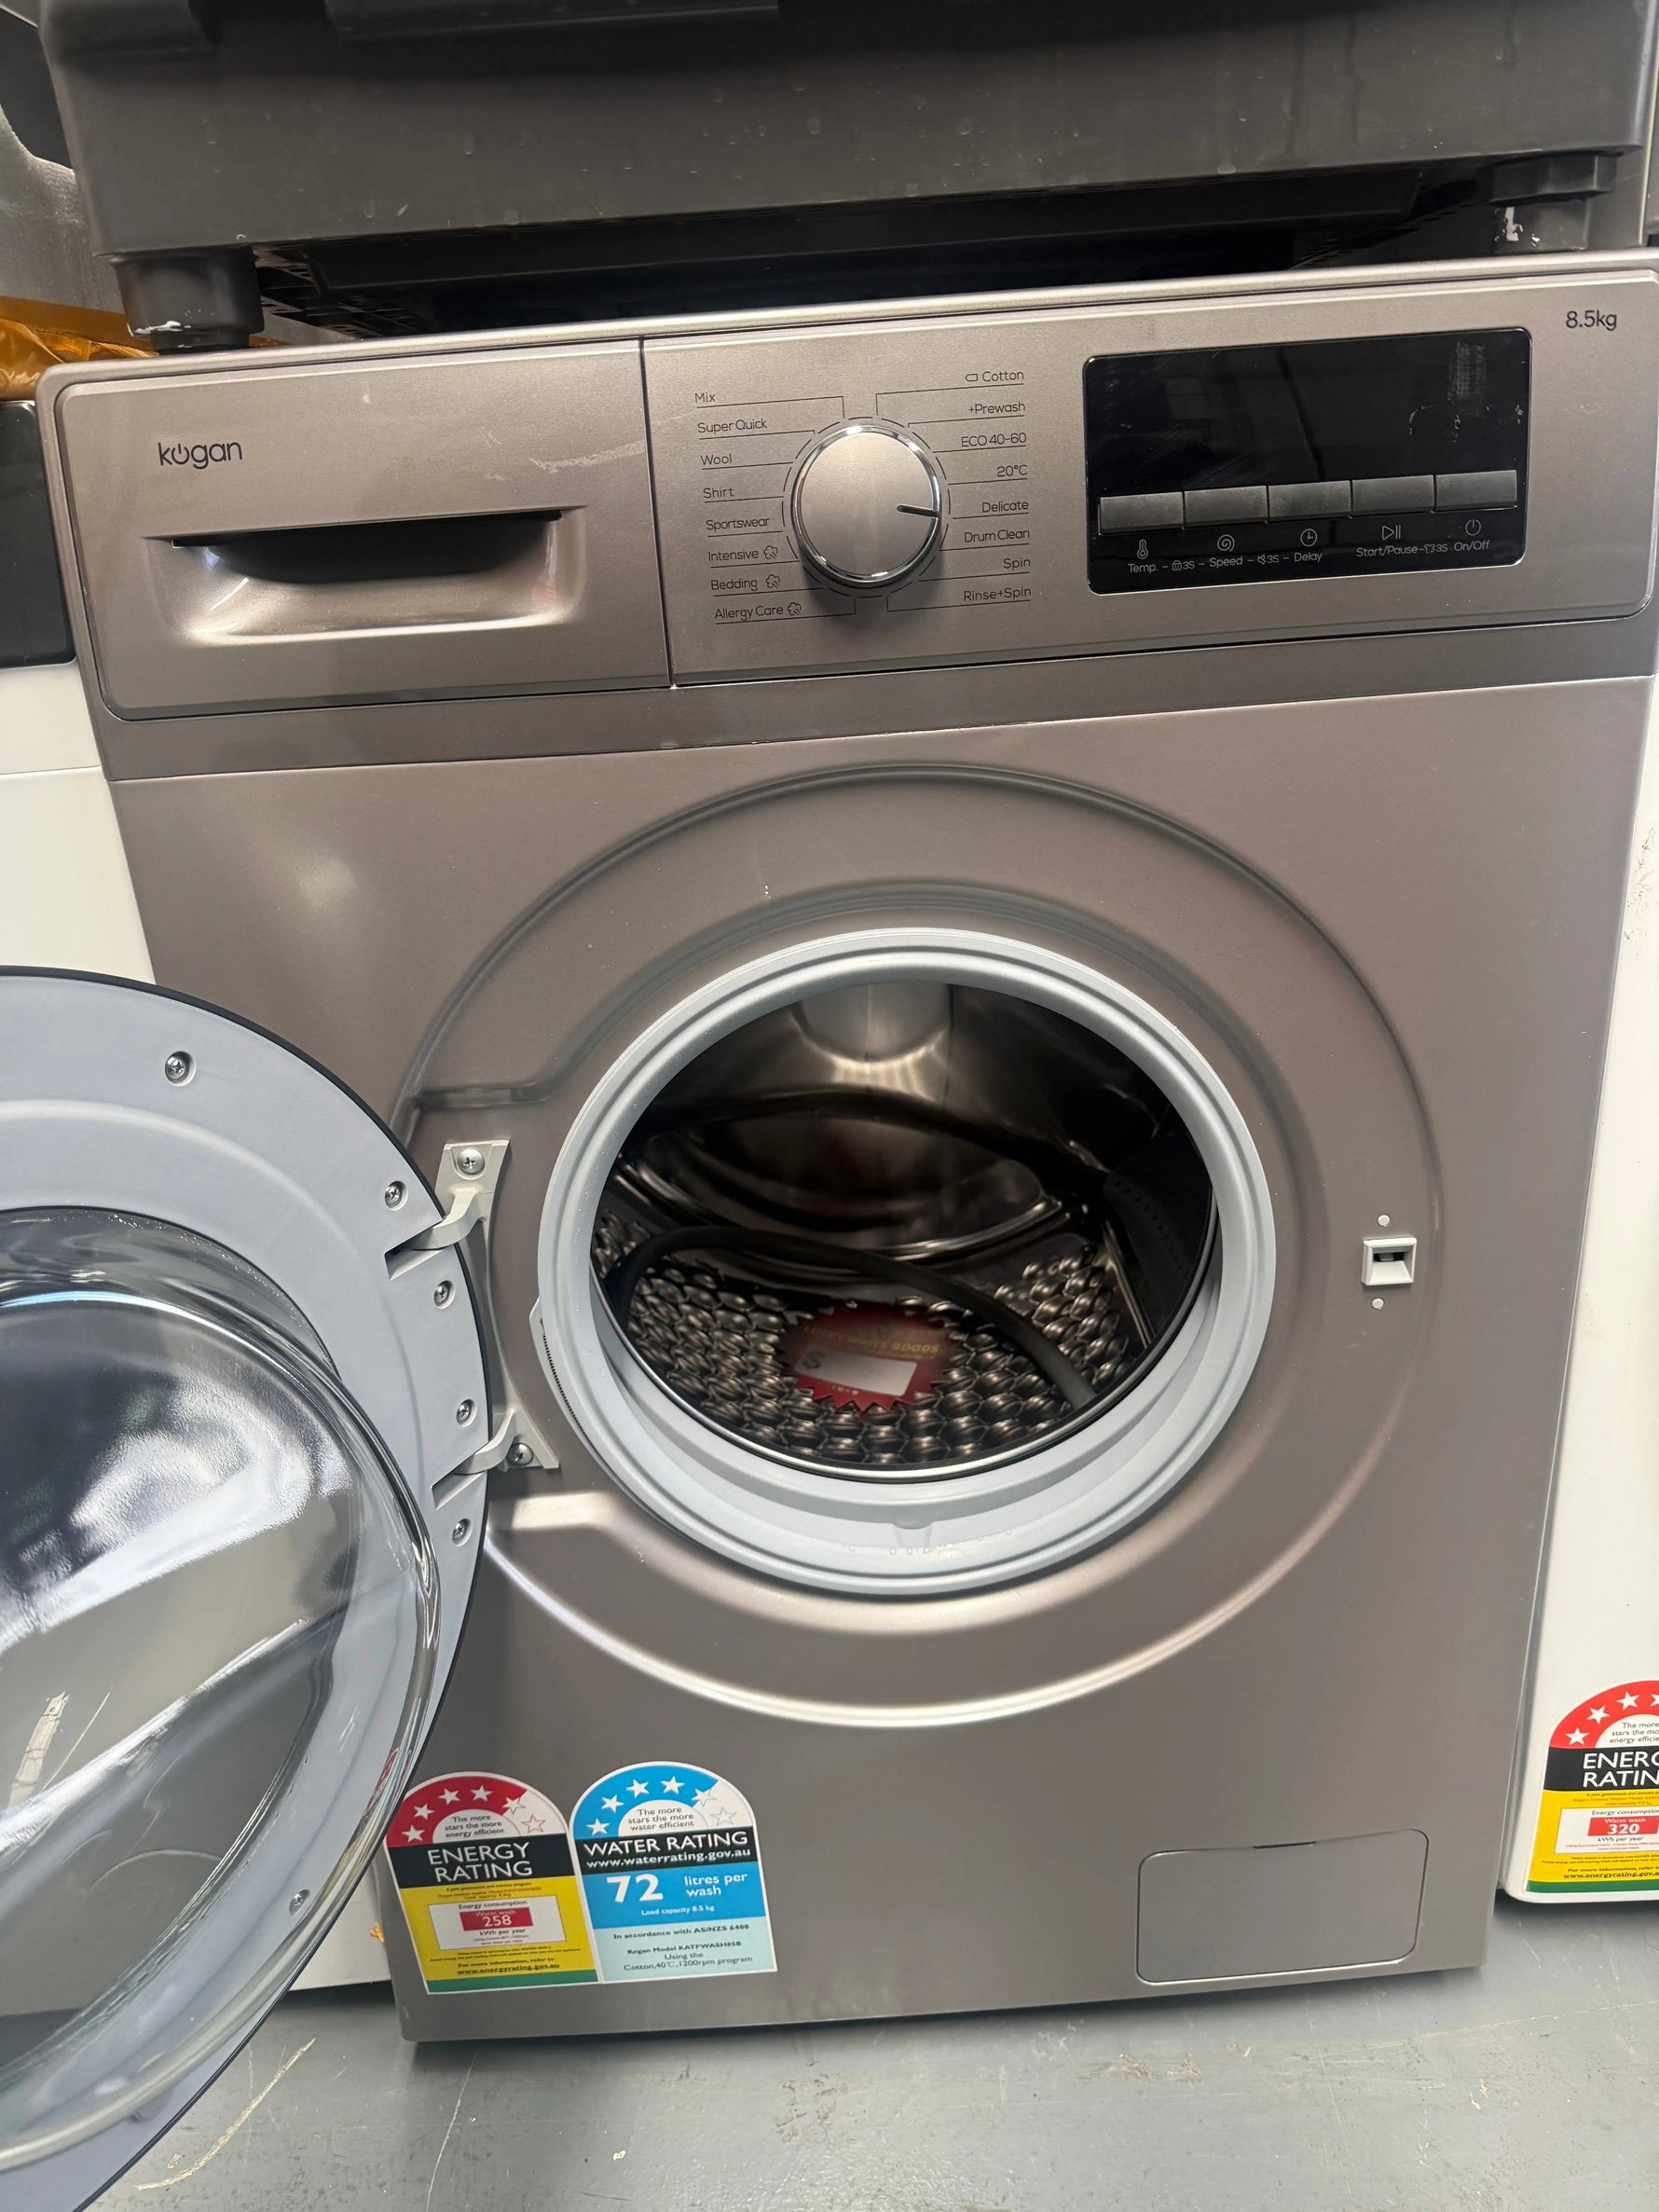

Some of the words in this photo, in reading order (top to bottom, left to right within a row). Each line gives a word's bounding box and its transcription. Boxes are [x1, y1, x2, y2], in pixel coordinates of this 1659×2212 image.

[1566, 309, 1618, 332] 8.5kg
[982, 370, 1024, 382] Cotton
[694, 392, 716, 403] Mix
[968, 402, 1025, 414] +Prewash
[698, 422, 734, 434] Super
[735, 419, 767, 431] Quick
[961, 435, 987, 447] ECO
[989, 433, 1026, 445] 40-60
[158, 442, 242, 469] kogan
[701, 454, 732, 465] Wool
[996, 465, 1028, 476] 20°C
[703, 487, 734, 499] Shirt
[981, 501, 1029, 513] Delicate
[706, 517, 770, 531] Sportswear
[964, 530, 995, 543] Drum
[997, 529, 1030, 540] Clean
[1454, 540, 1490, 551] On/Off
[708, 549, 759, 561] Intensive
[1003, 556, 1030, 570] Spin
[1128, 563, 1159, 573] Temp.
[1209, 556, 1242, 569] Speed
[1295, 552, 1323, 563] Delay
[711, 577, 758, 591] Bedding
[964, 587, 1031, 601] Rinse+Spin
[715, 606, 754, 621] Allergy
[756, 604, 784, 616] Care
[891, 1342, 939, 1353] GOODS
[1584, 1770, 1659, 1787] RATIN
[659, 1820, 694, 1829] efficient
[1608, 1823, 1639, 1834] 320
[583, 1838, 661, 1857] WATER
[666, 1832, 747, 1851] RATING
[427, 1842, 529, 1865] ENERGY
[586, 1848, 751, 1869] www.waterrating.gov.au
[434, 1861, 532, 1882] RATING
[684, 1875, 720, 1887] litres
[724, 1873, 747, 1886] per
[607, 1874, 664, 1903] 72
[686, 1885, 721, 1897] wash
[484, 1900, 528, 1908] consumption
[483, 1916, 512, 1927] 258
[624, 1930, 671, 1939] accordance
[665, 1952, 688, 1960] Using
[718, 1957, 753, 1965] program
